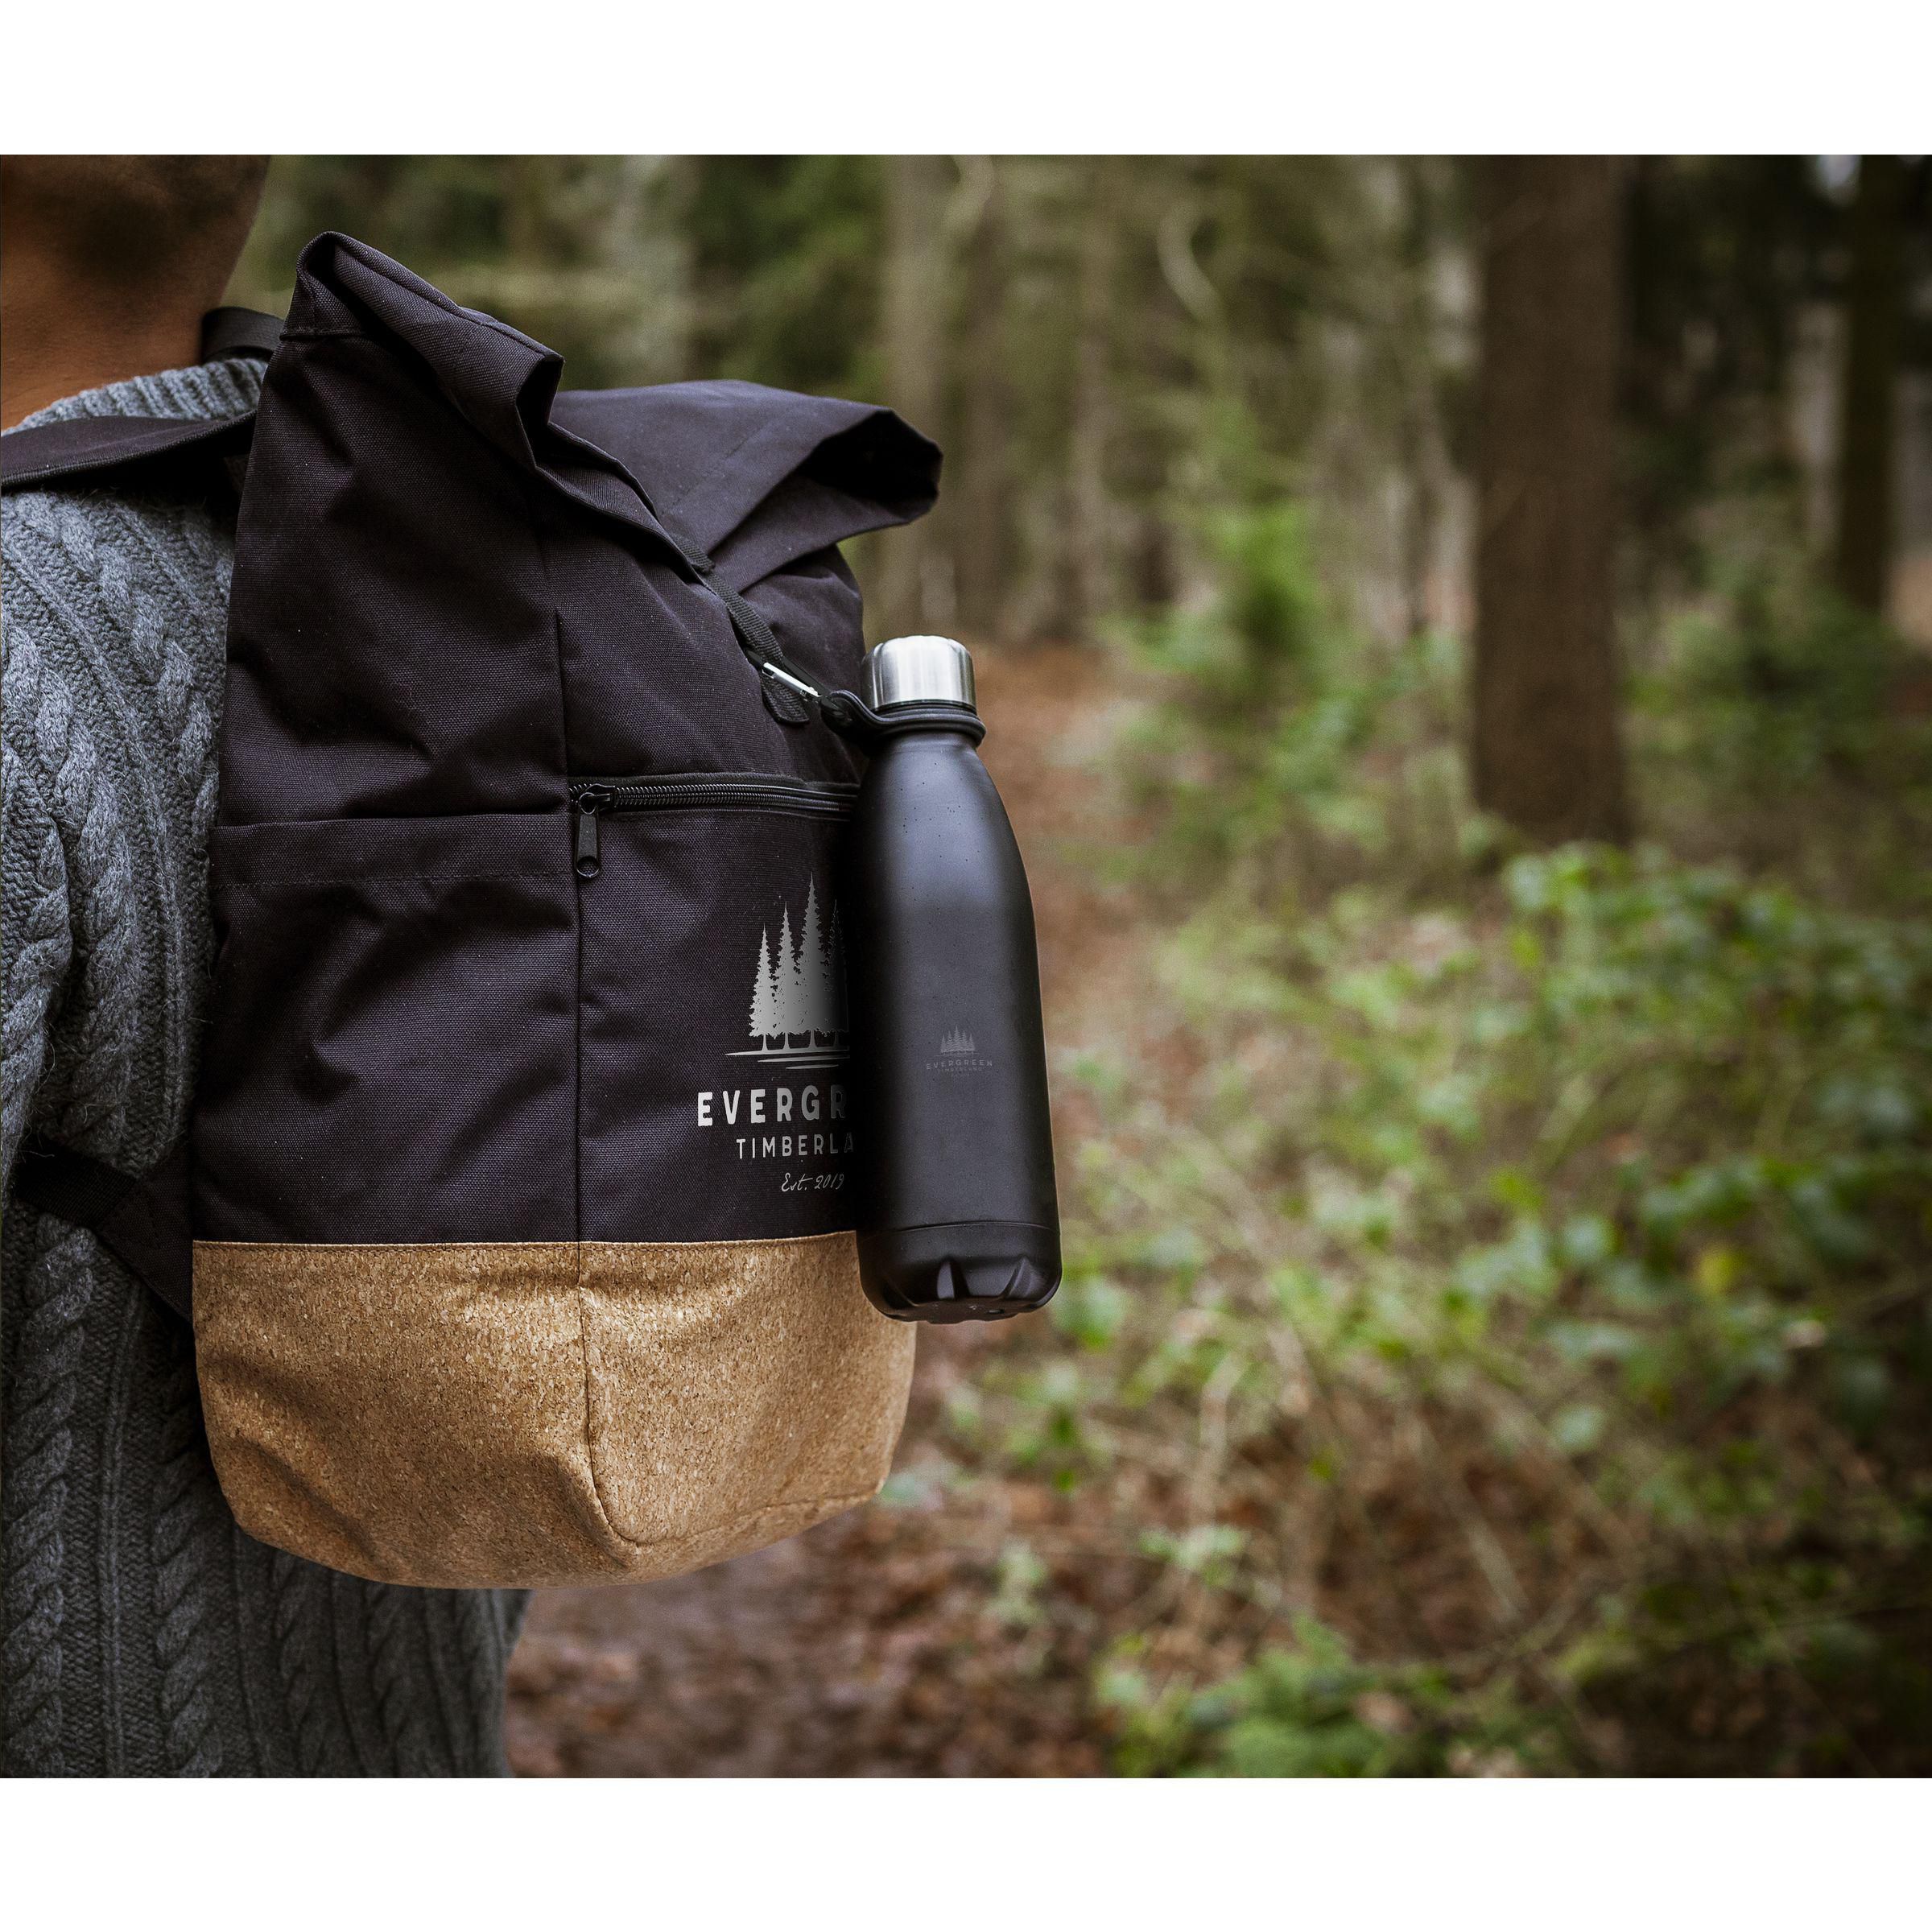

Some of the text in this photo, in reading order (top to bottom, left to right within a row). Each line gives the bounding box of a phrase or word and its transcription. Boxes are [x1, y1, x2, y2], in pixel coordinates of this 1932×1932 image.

[926, 1059, 993, 1070] EVERGREEN
[736, 1132, 854, 1159] TIMBERLA
[781, 1172, 844, 1192] Est. 2019
